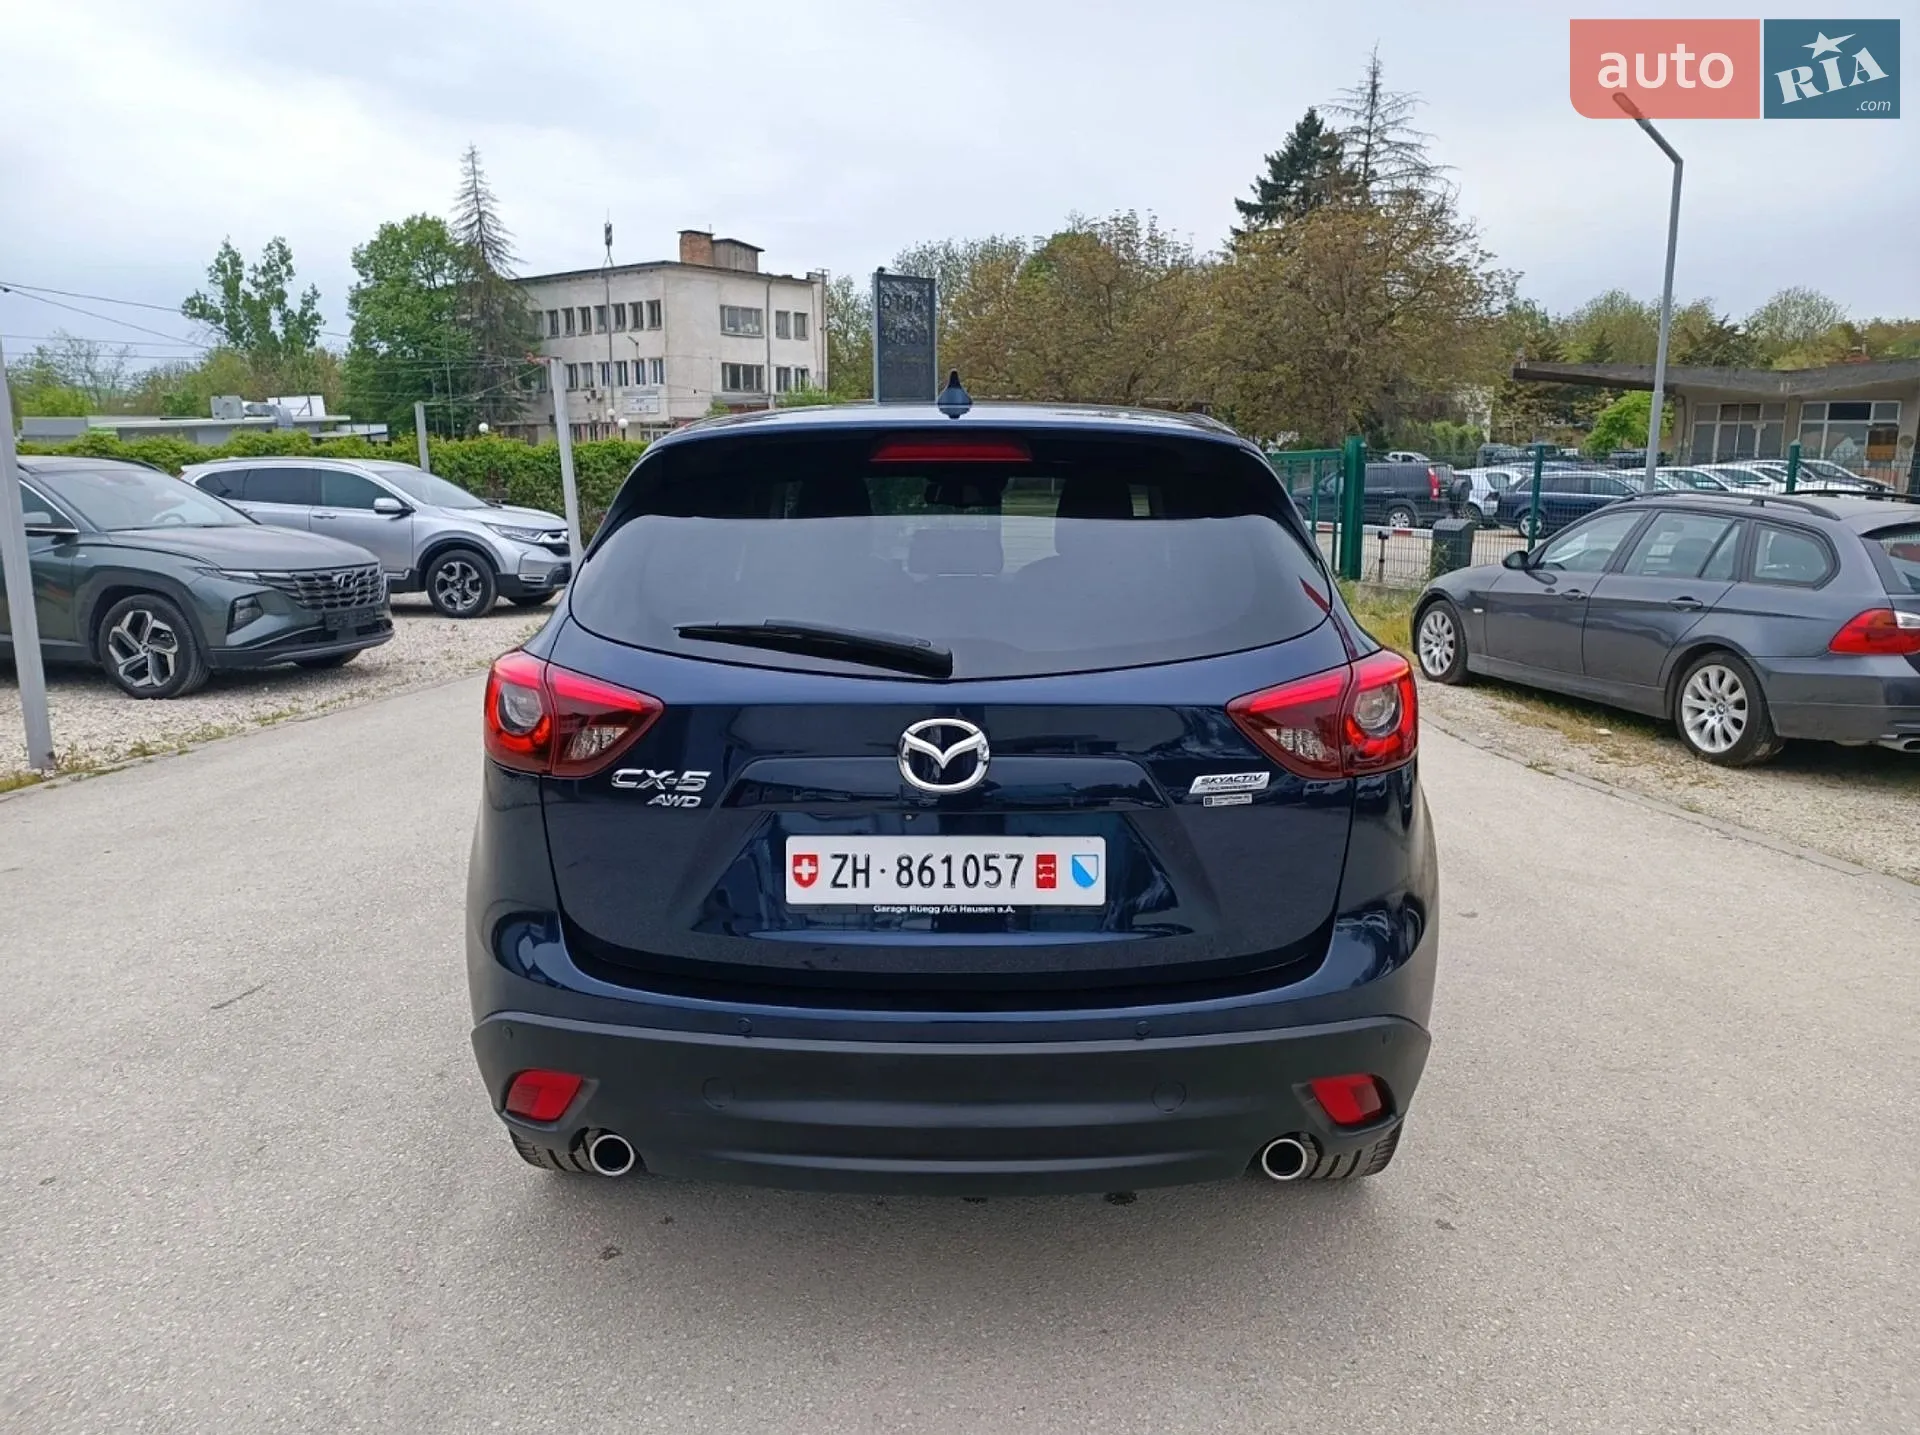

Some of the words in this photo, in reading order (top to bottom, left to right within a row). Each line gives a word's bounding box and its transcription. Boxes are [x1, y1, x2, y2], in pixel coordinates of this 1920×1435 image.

[611, 768, 712, 792] CX-5
[1200, 773, 1263, 785] SKYACTIV
[647, 794, 702, 807] AWD
[829, 853, 870, 889] ZH
[895, 853, 1025, 889] 861057
[873, 905, 907, 914] Garage
[942, 905, 957, 913] AG
